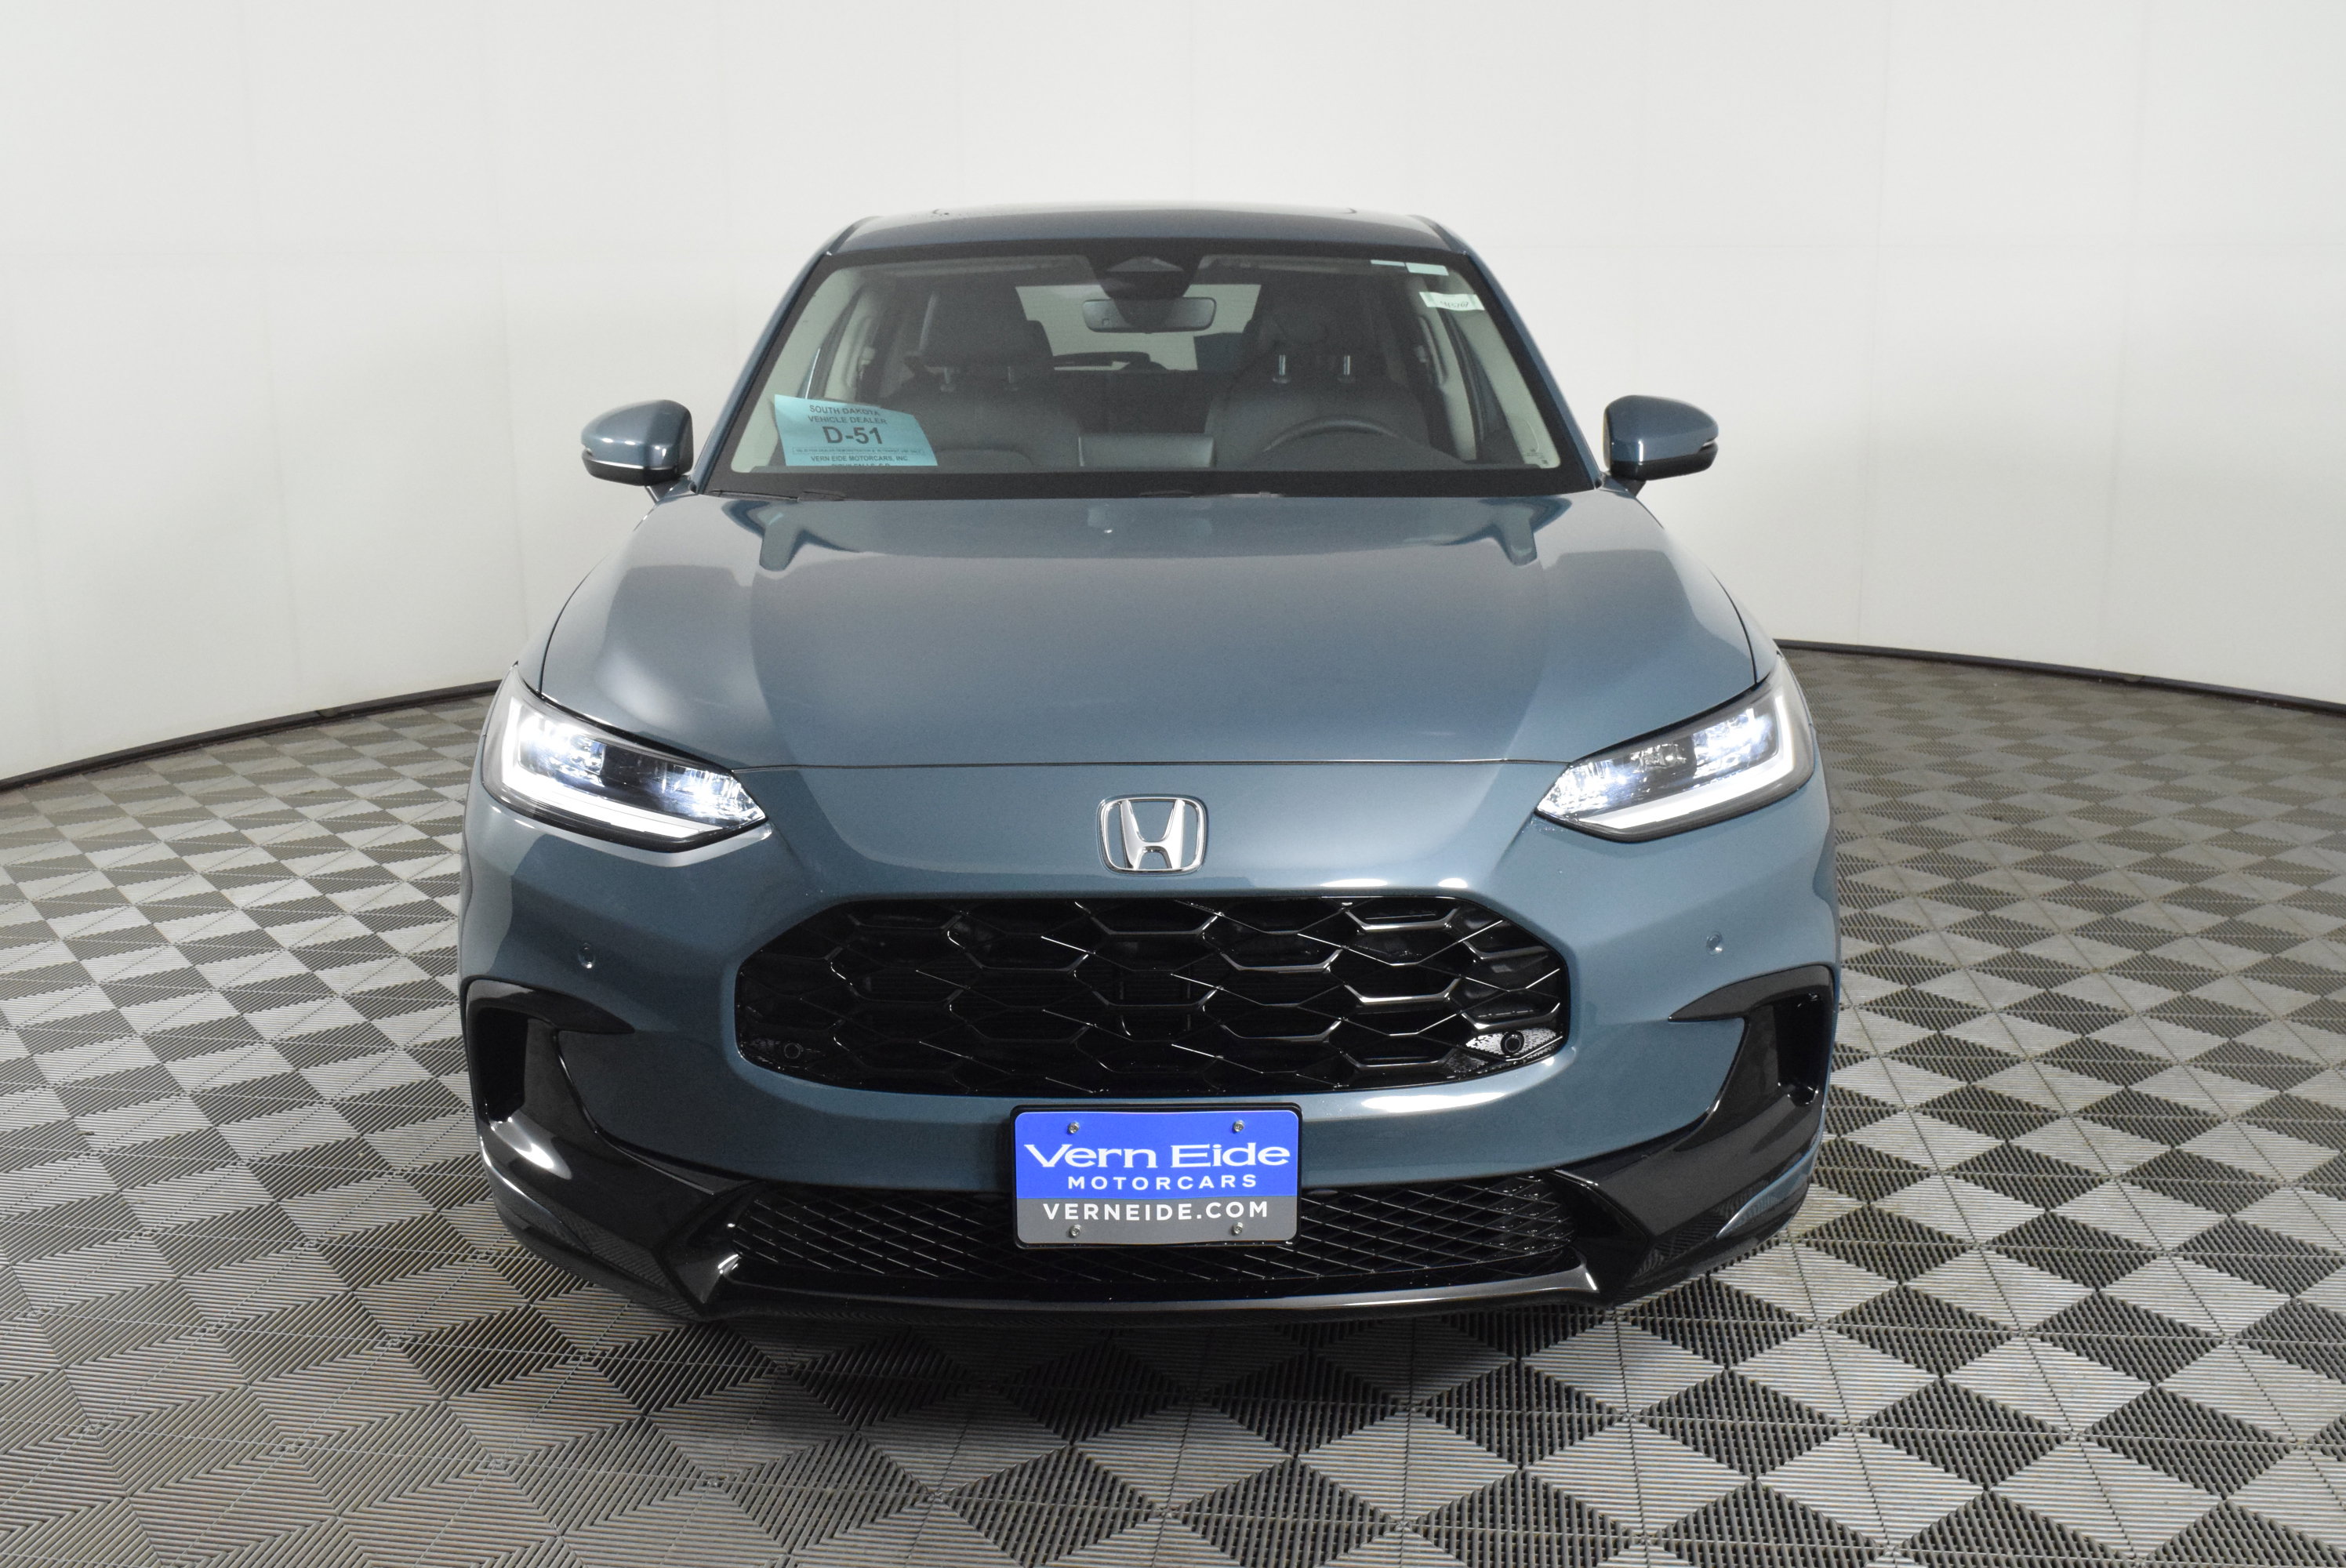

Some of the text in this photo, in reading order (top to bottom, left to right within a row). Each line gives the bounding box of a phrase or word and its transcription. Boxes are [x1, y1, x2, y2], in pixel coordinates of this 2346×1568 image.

[809, 405, 881, 416] SOUTH DAKOTA
[822, 426, 884, 445] D-51
[1023, 1142, 1291, 1168] Vern Eide
[1068, 1174, 1257, 1190] MOTORCARS
[1043, 1201, 1268, 1221] VERNEIDE.COM
